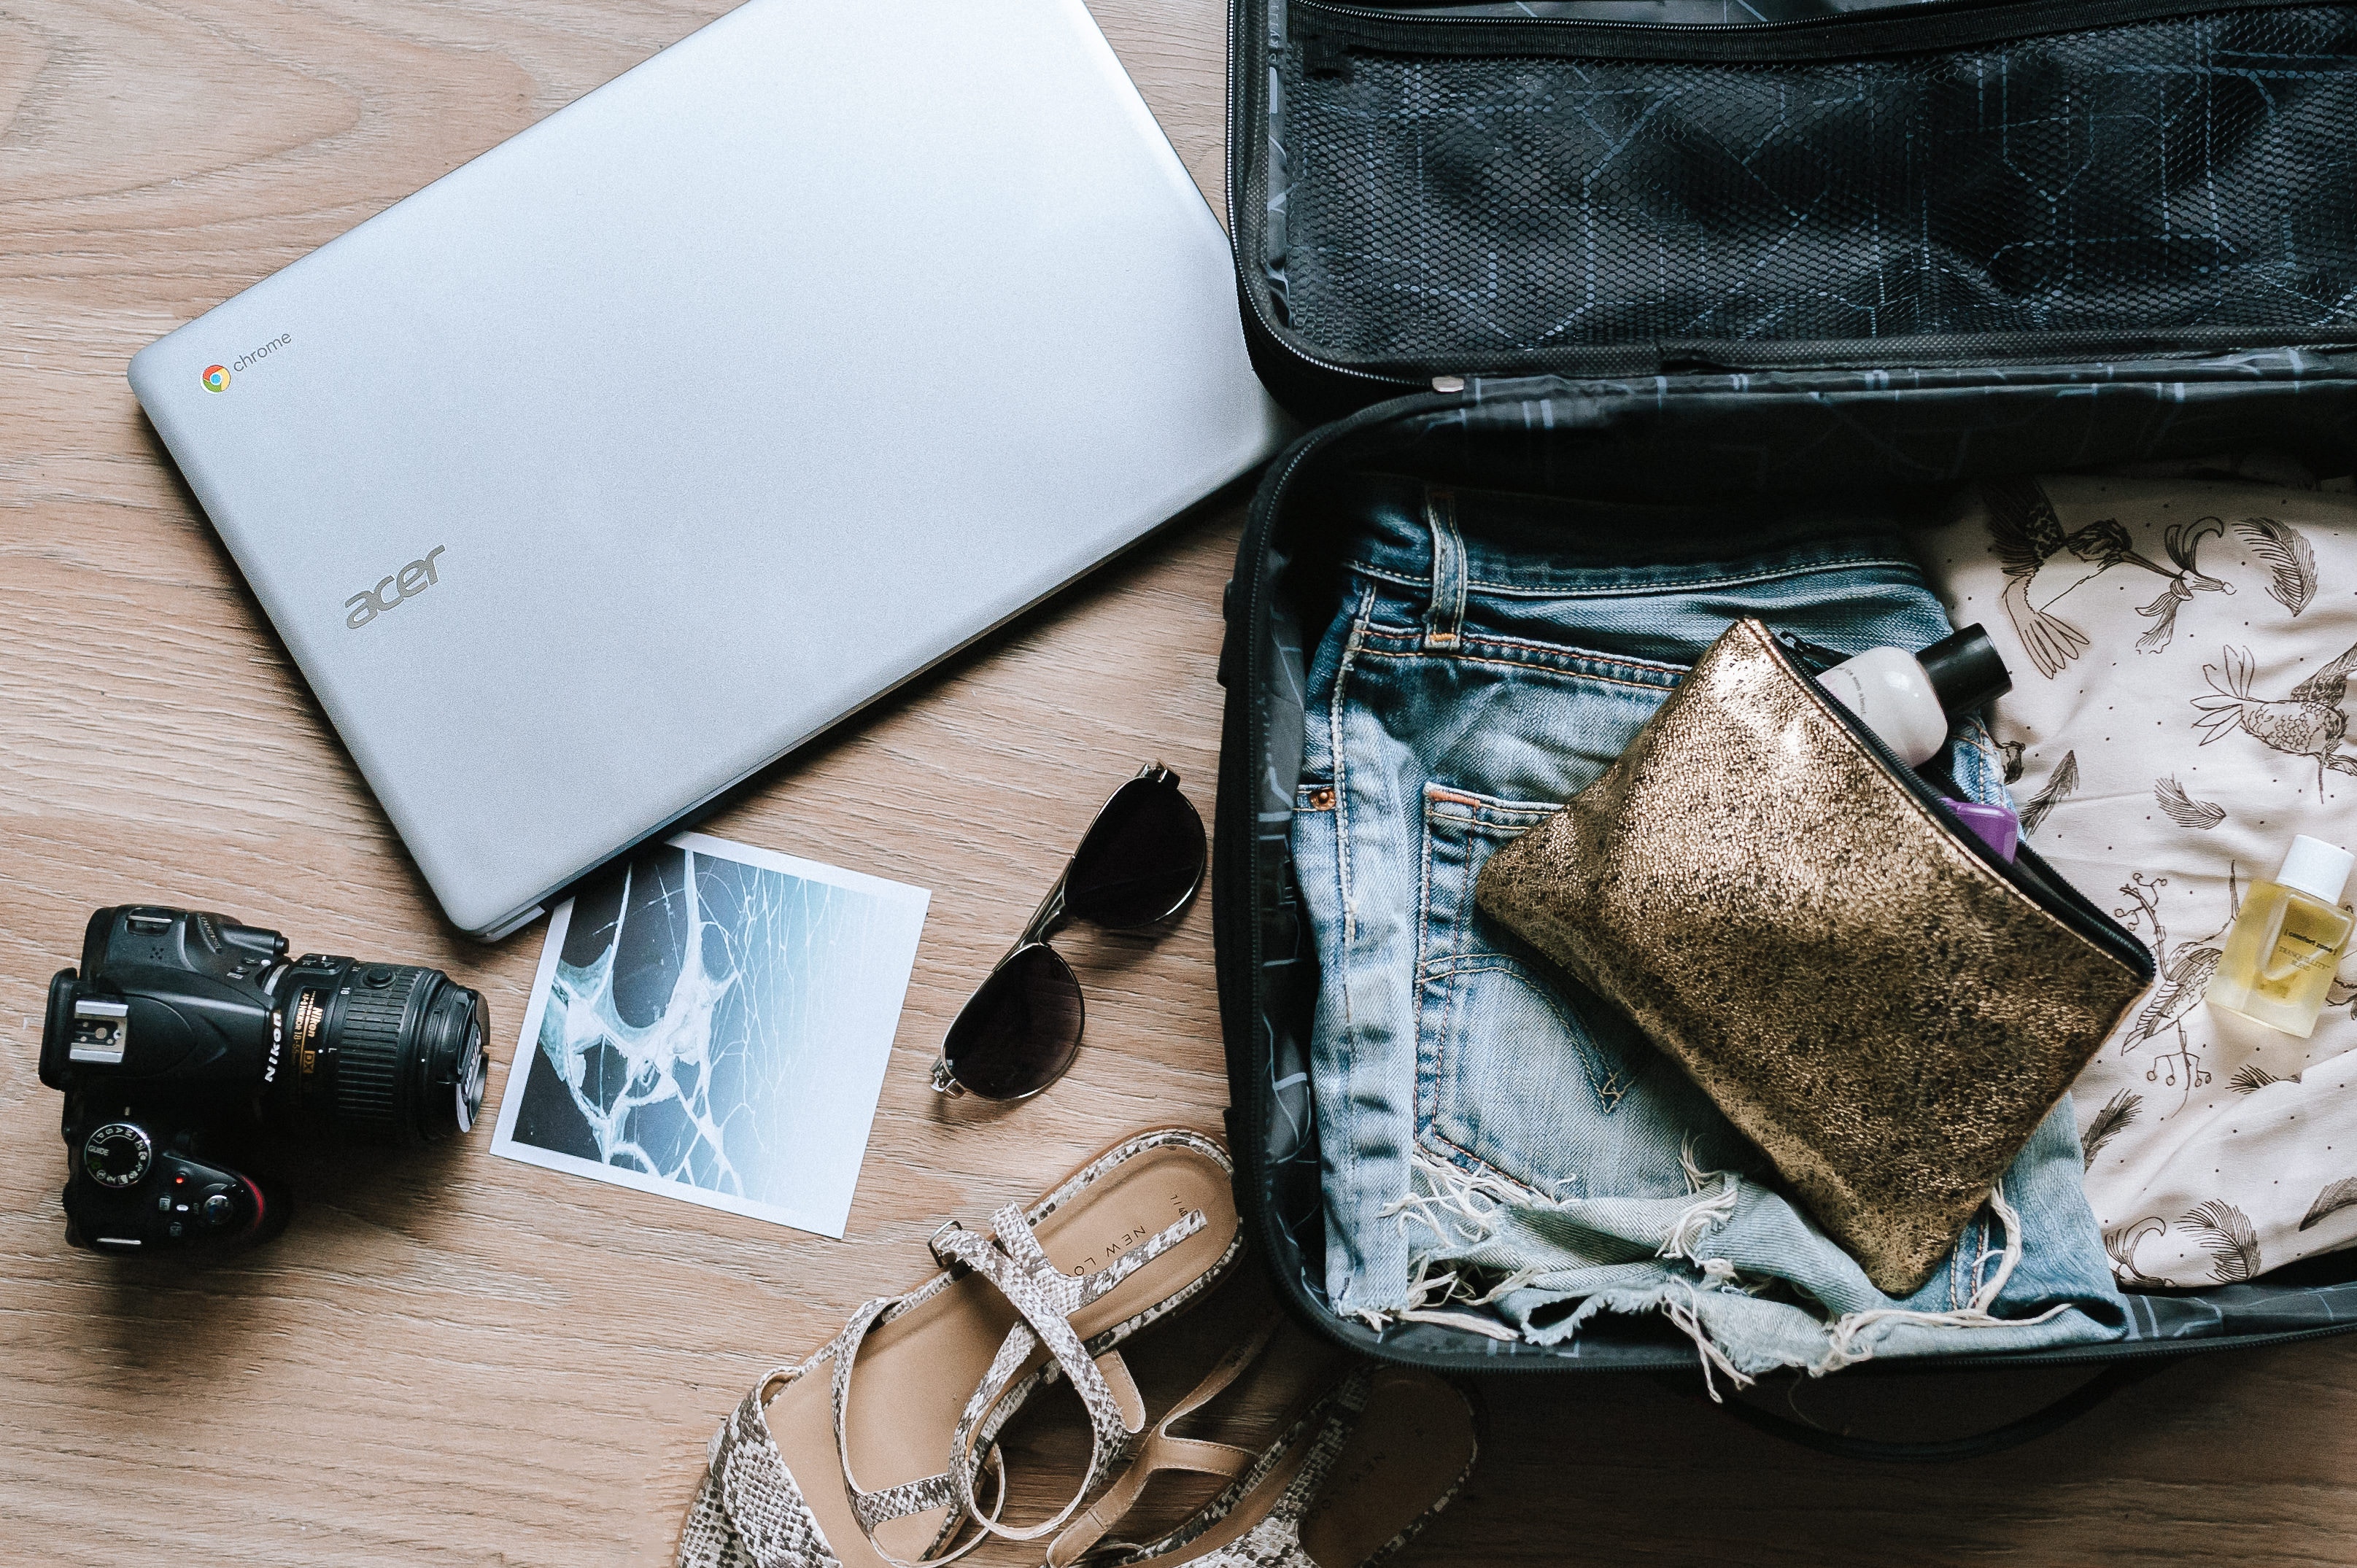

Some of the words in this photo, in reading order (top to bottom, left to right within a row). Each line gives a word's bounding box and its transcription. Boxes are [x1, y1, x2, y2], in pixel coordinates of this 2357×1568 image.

[233, 333, 293, 373] chrome
[344, 545, 446, 629] acer
[307, 1006, 324, 1038] Nikon
[264, 1012, 282, 1082] Nikon
[303, 1051, 316, 1074] DX
[1105, 1225, 1146, 1258] NEW
[1064, 1257, 1096, 1278] LO
